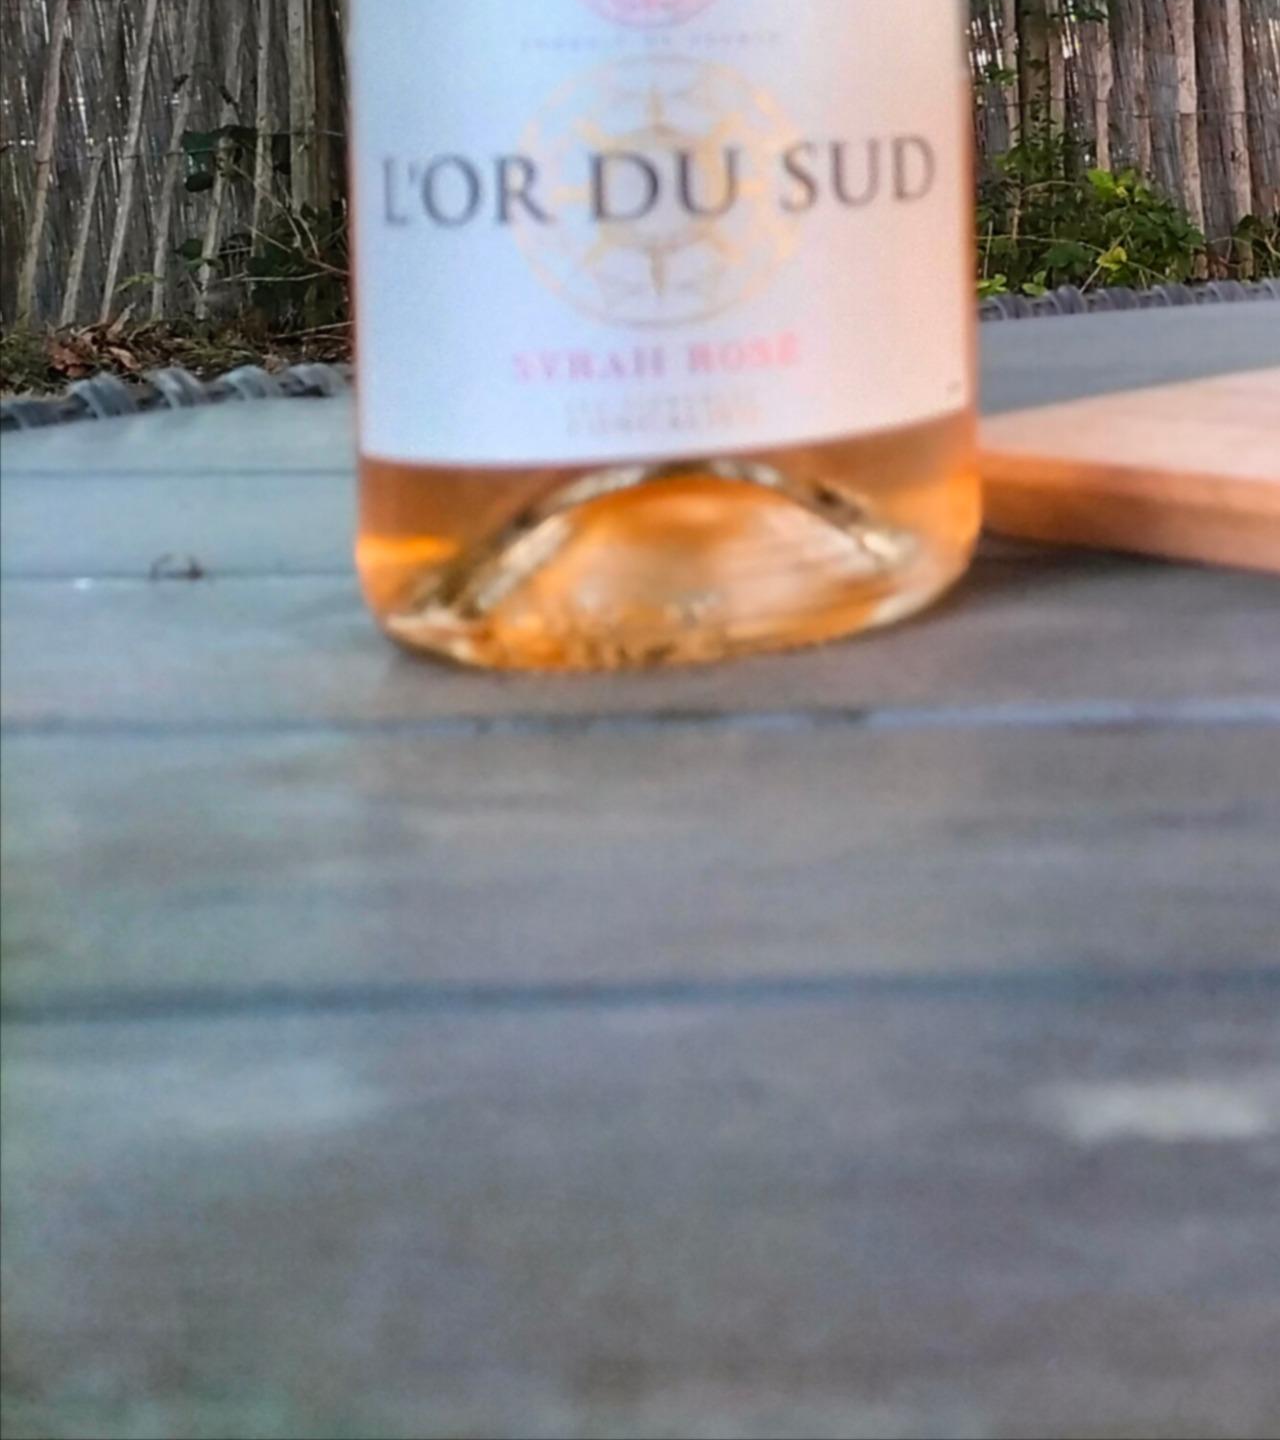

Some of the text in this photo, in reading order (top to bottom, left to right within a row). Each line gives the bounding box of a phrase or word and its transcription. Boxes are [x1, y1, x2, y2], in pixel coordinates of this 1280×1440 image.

[381, 134, 938, 228] L'OR DU SUD
